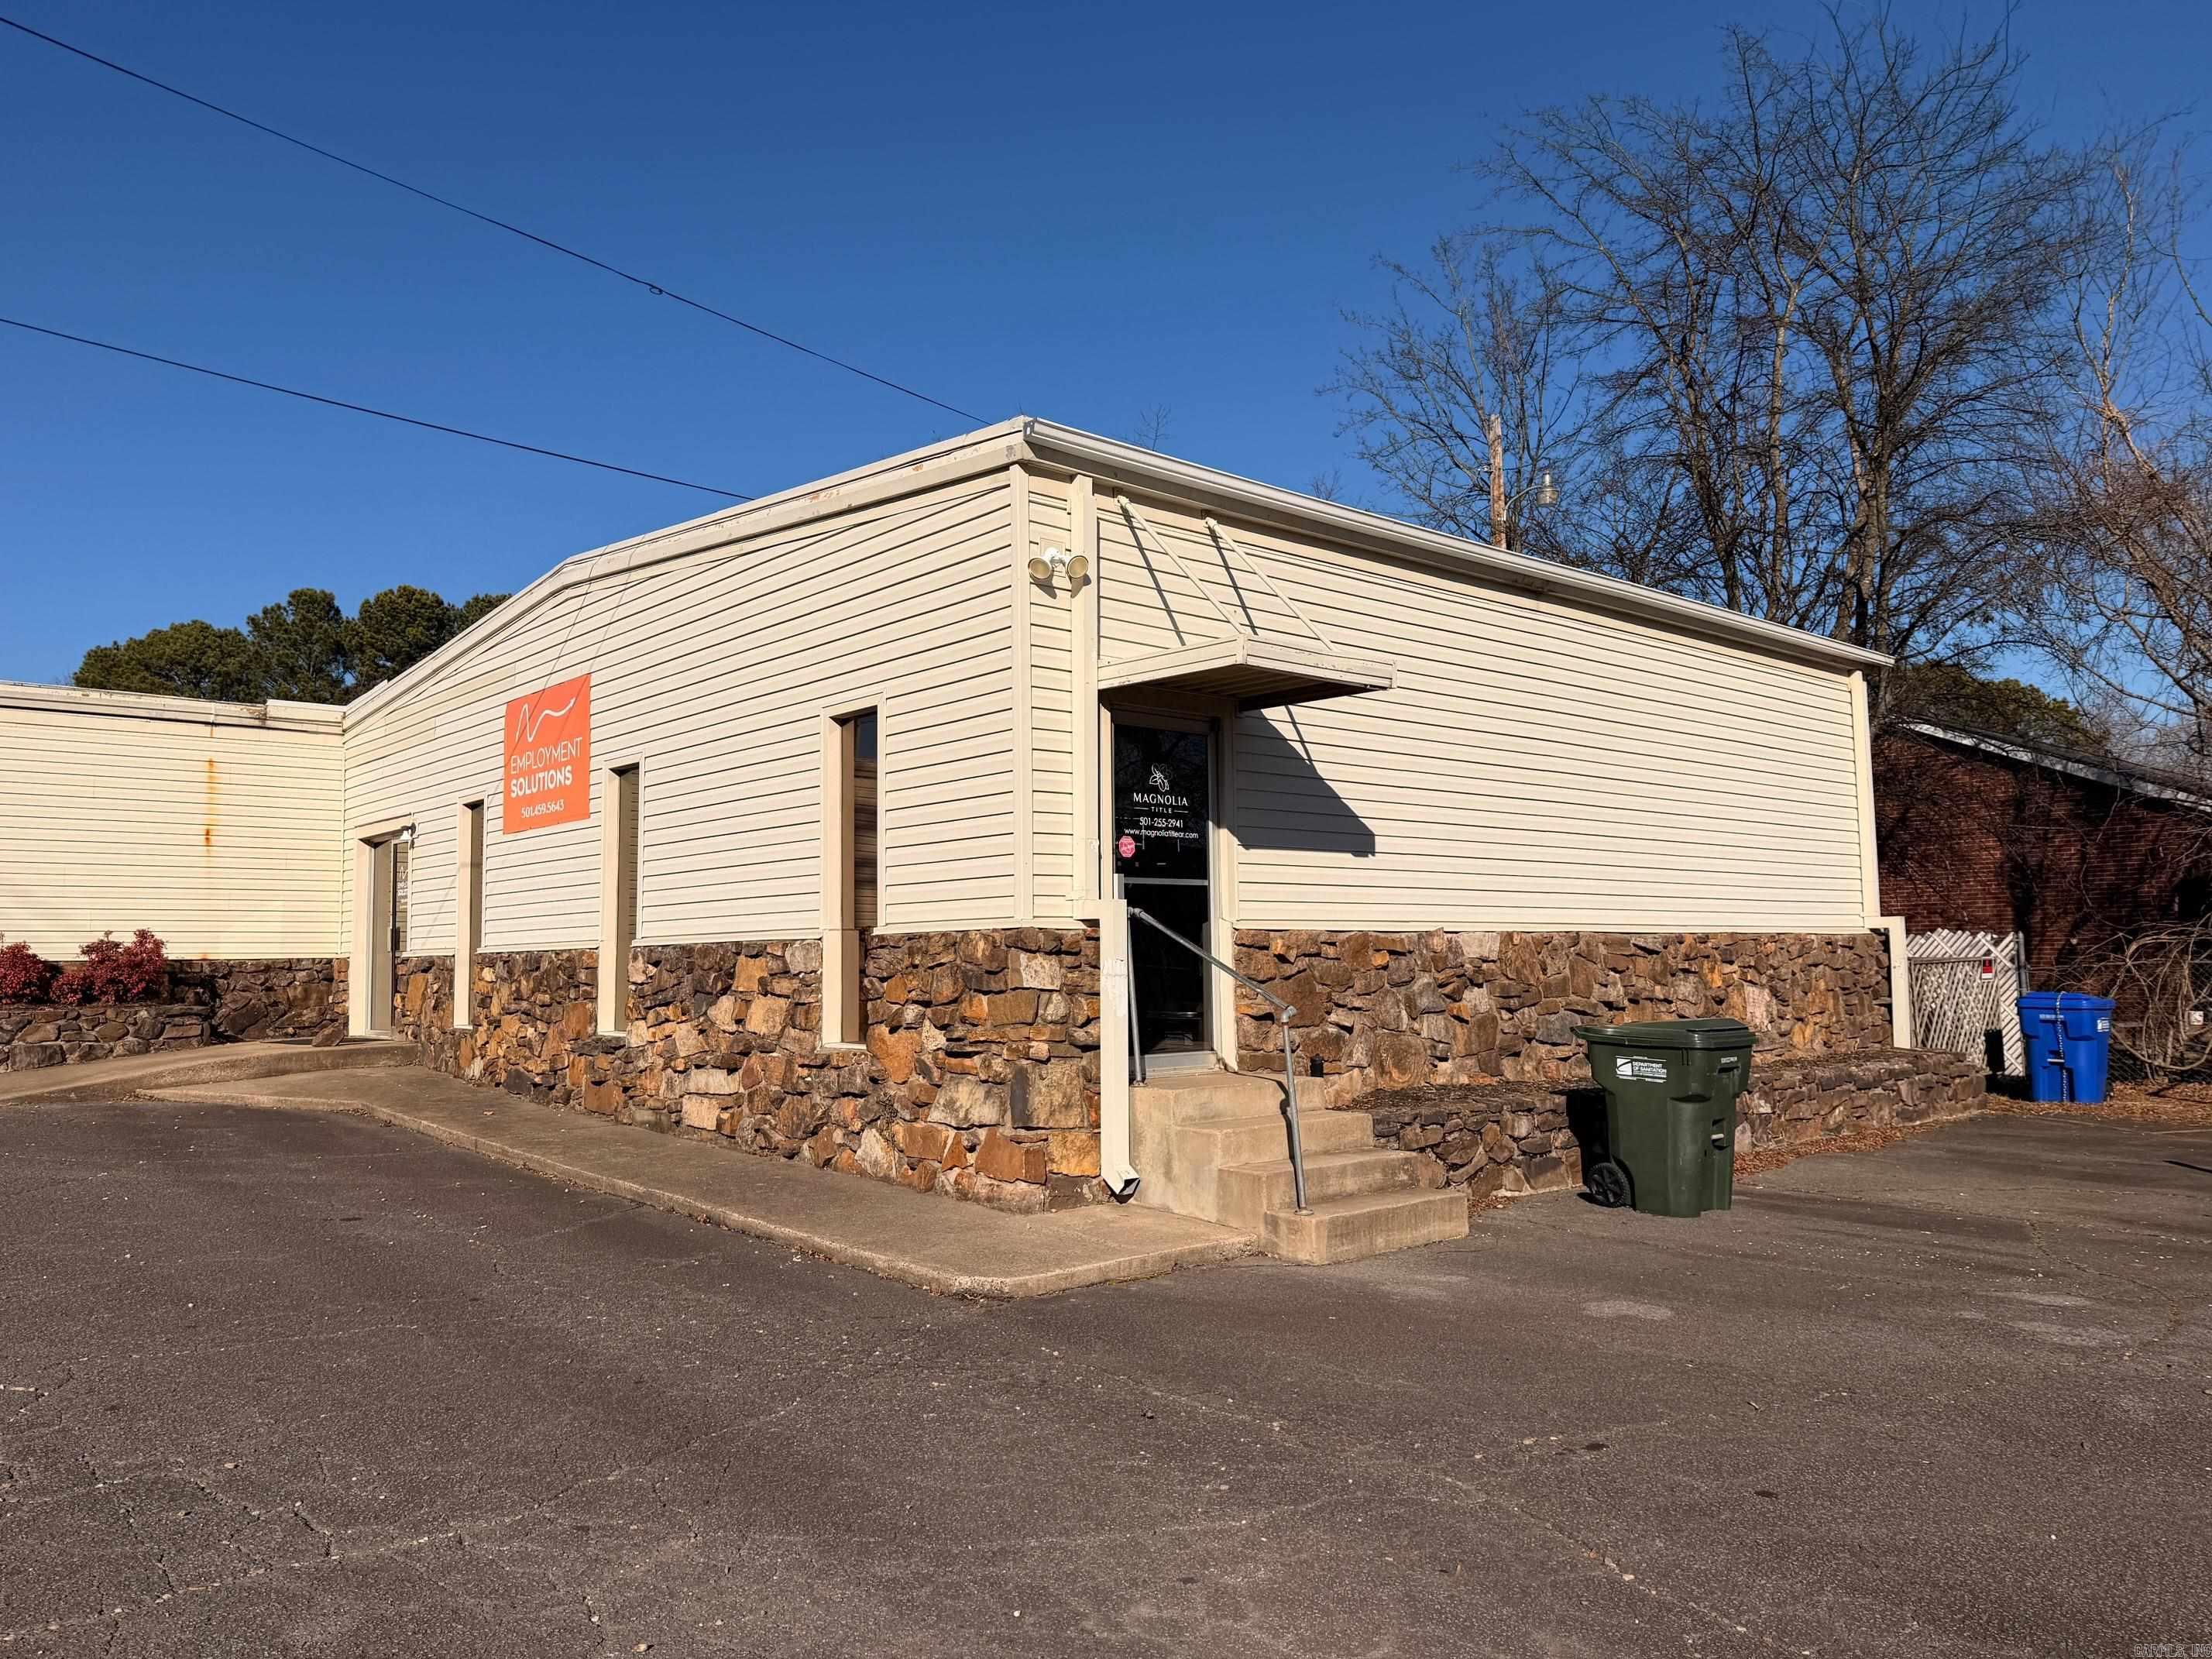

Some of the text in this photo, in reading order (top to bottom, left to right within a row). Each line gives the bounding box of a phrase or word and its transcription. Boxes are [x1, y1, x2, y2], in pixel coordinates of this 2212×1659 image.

[510, 737, 582, 774] EMPLOYMENT
[510, 766, 572, 798] SOLUTIONS
[520, 799, 564, 819] 501.459.5643
[1133, 792, 1188, 806] MAGNOLIA
[1139, 817, 1183, 828] 501-255-2941
